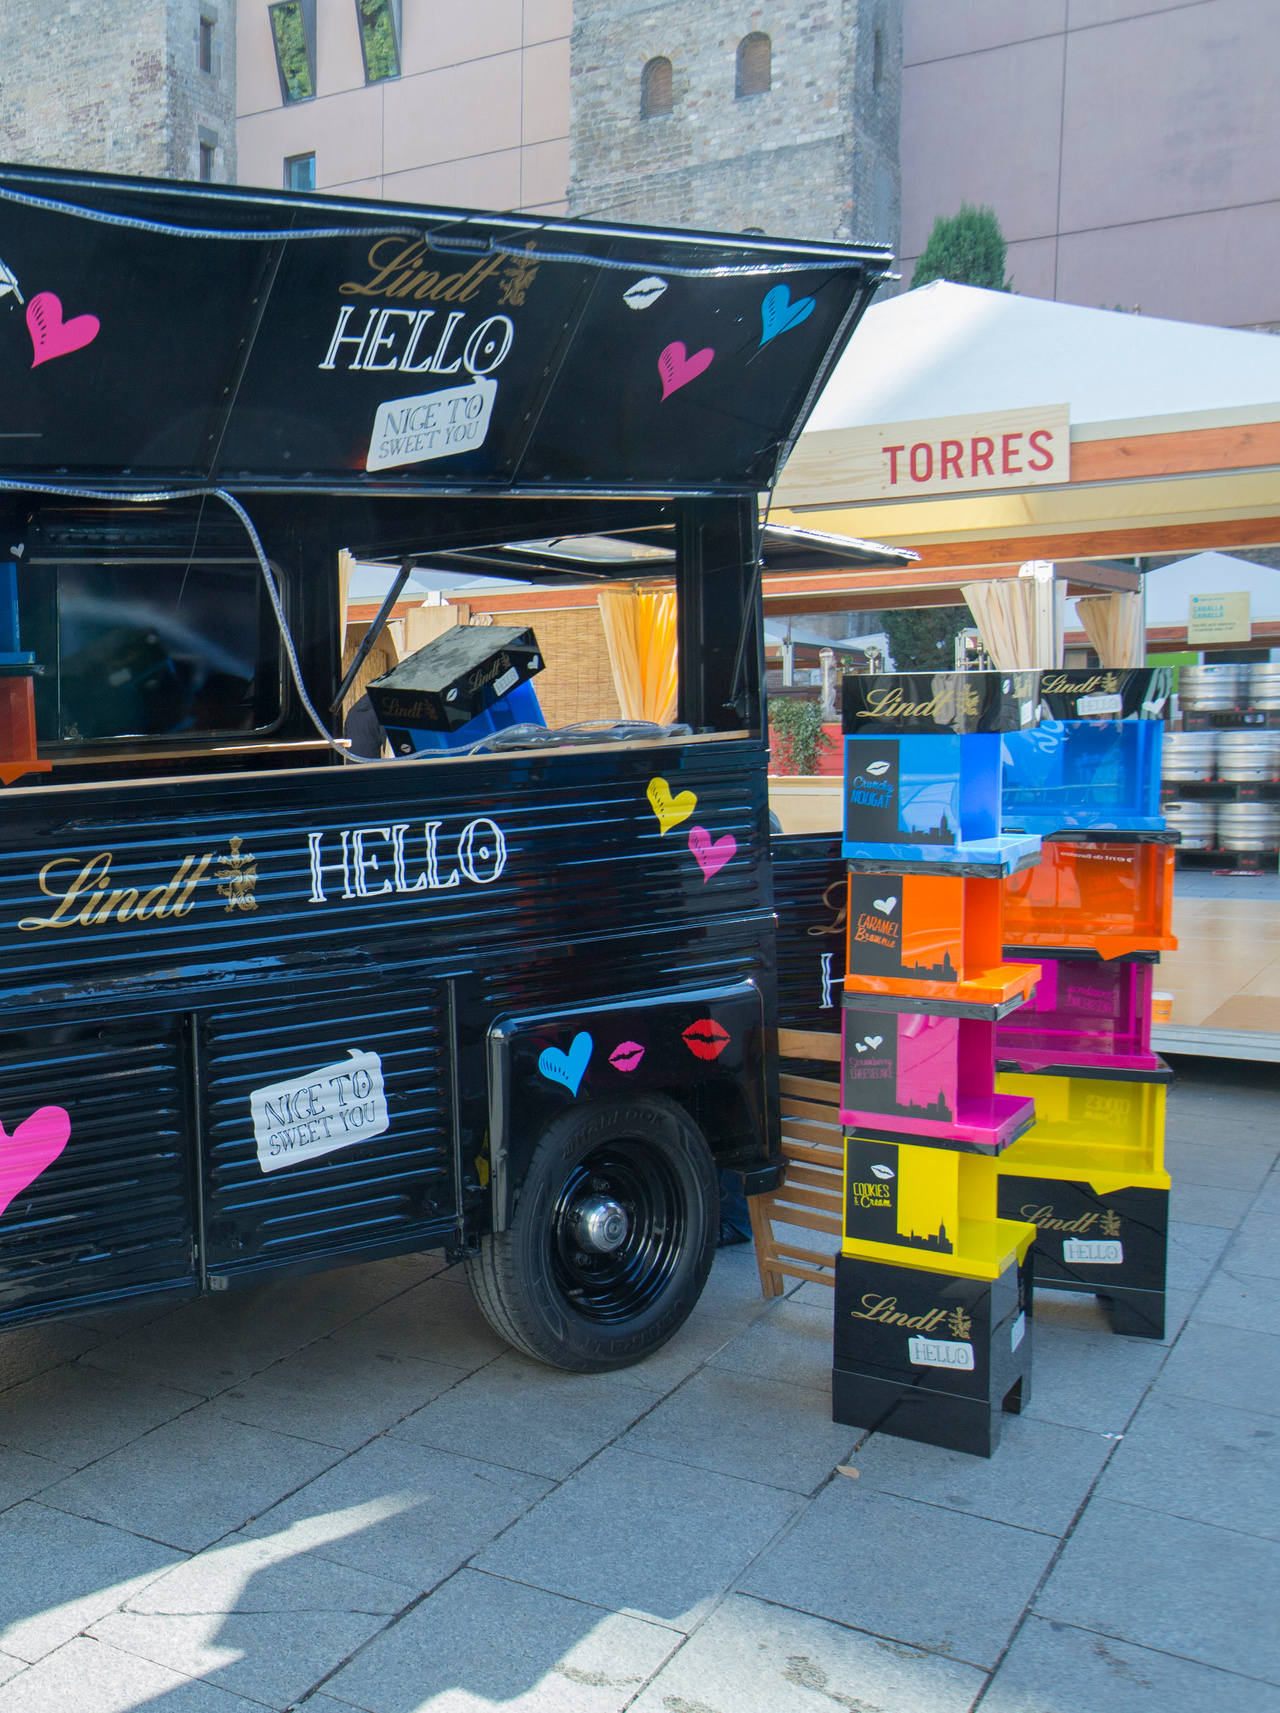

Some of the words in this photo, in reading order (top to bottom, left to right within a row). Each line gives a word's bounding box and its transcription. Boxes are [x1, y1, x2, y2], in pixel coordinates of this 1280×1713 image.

[338, 236, 508, 303] Lindt
[318, 305, 515, 375] HELLO
[383, 402, 441, 437] NICE
[448, 393, 484, 424] TO
[379, 430, 440, 459] SWEET
[445, 421, 480, 445] YOU
[882, 429, 1055, 485] TORRES
[468, 658, 501, 694] Lindt
[1041, 674, 1103, 694] Lindt
[381, 697, 421, 719] Lindt
[856, 687, 955, 717] Lindt
[1081, 698, 1120, 713] HELLO
[851, 789, 892, 808] NOUGAT
[17, 850, 218, 931] Lindt
[308, 818, 508, 902] HELLO
[854, 927, 896, 948] Brownie
[857, 913, 899, 938] CARAMEL
[850, 1067, 894, 1080] CHEESECAKE
[264, 1083, 325, 1130] NICE
[329, 1069, 373, 1107] TO
[269, 1114, 334, 1156] SWEET
[338, 1100, 376, 1131] YOU
[853, 1182, 890, 1198] COOKIES
[860, 1195, 892, 1208] Cream
[1020, 1204, 1100, 1234] Lindt
[1069, 1240, 1119, 1260] HELLO
[851, 1293, 948, 1333] Lindt
[914, 1343, 970, 1366] HELLO
